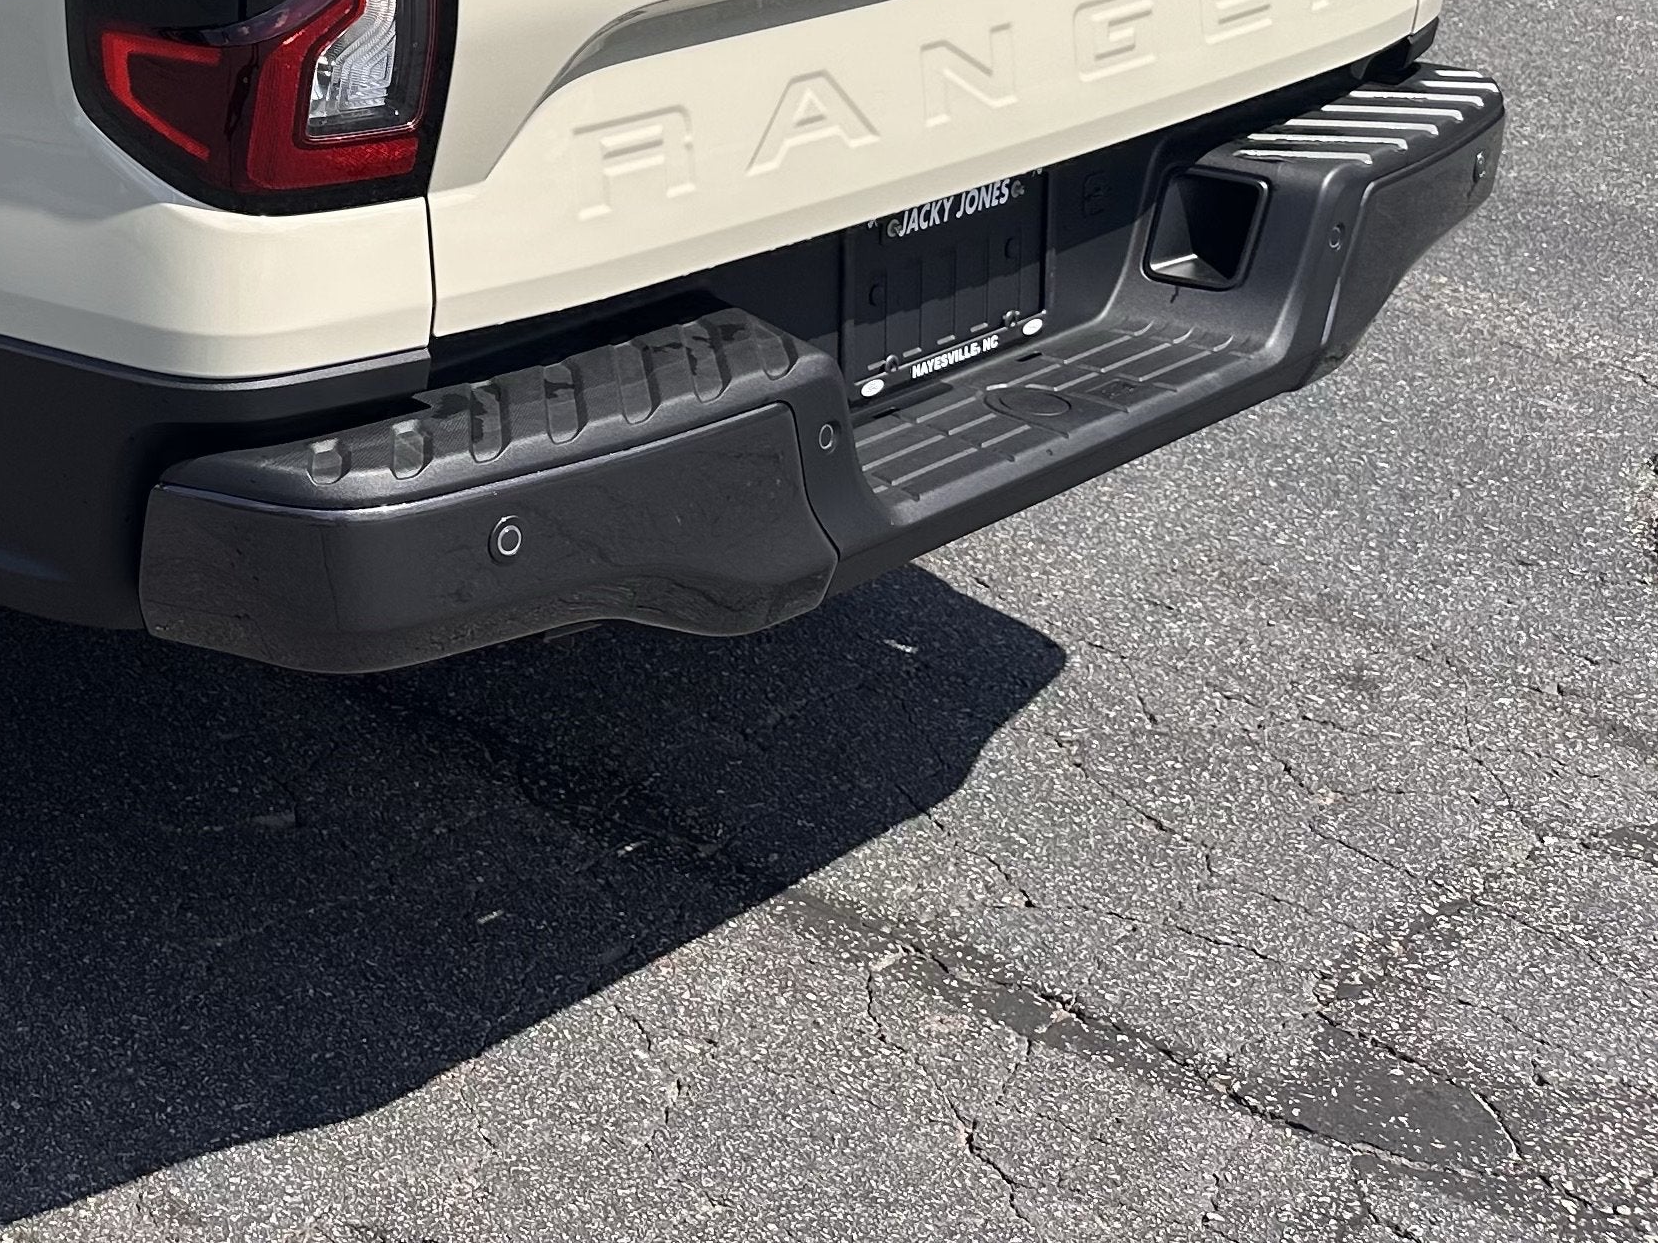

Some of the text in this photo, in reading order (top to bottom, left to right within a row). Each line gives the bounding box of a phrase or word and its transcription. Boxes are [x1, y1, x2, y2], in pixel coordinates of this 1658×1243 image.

[897, 178, 1010, 237] JACKY JONES
[911, 334, 999, 379] HAYESVILLE, NC
